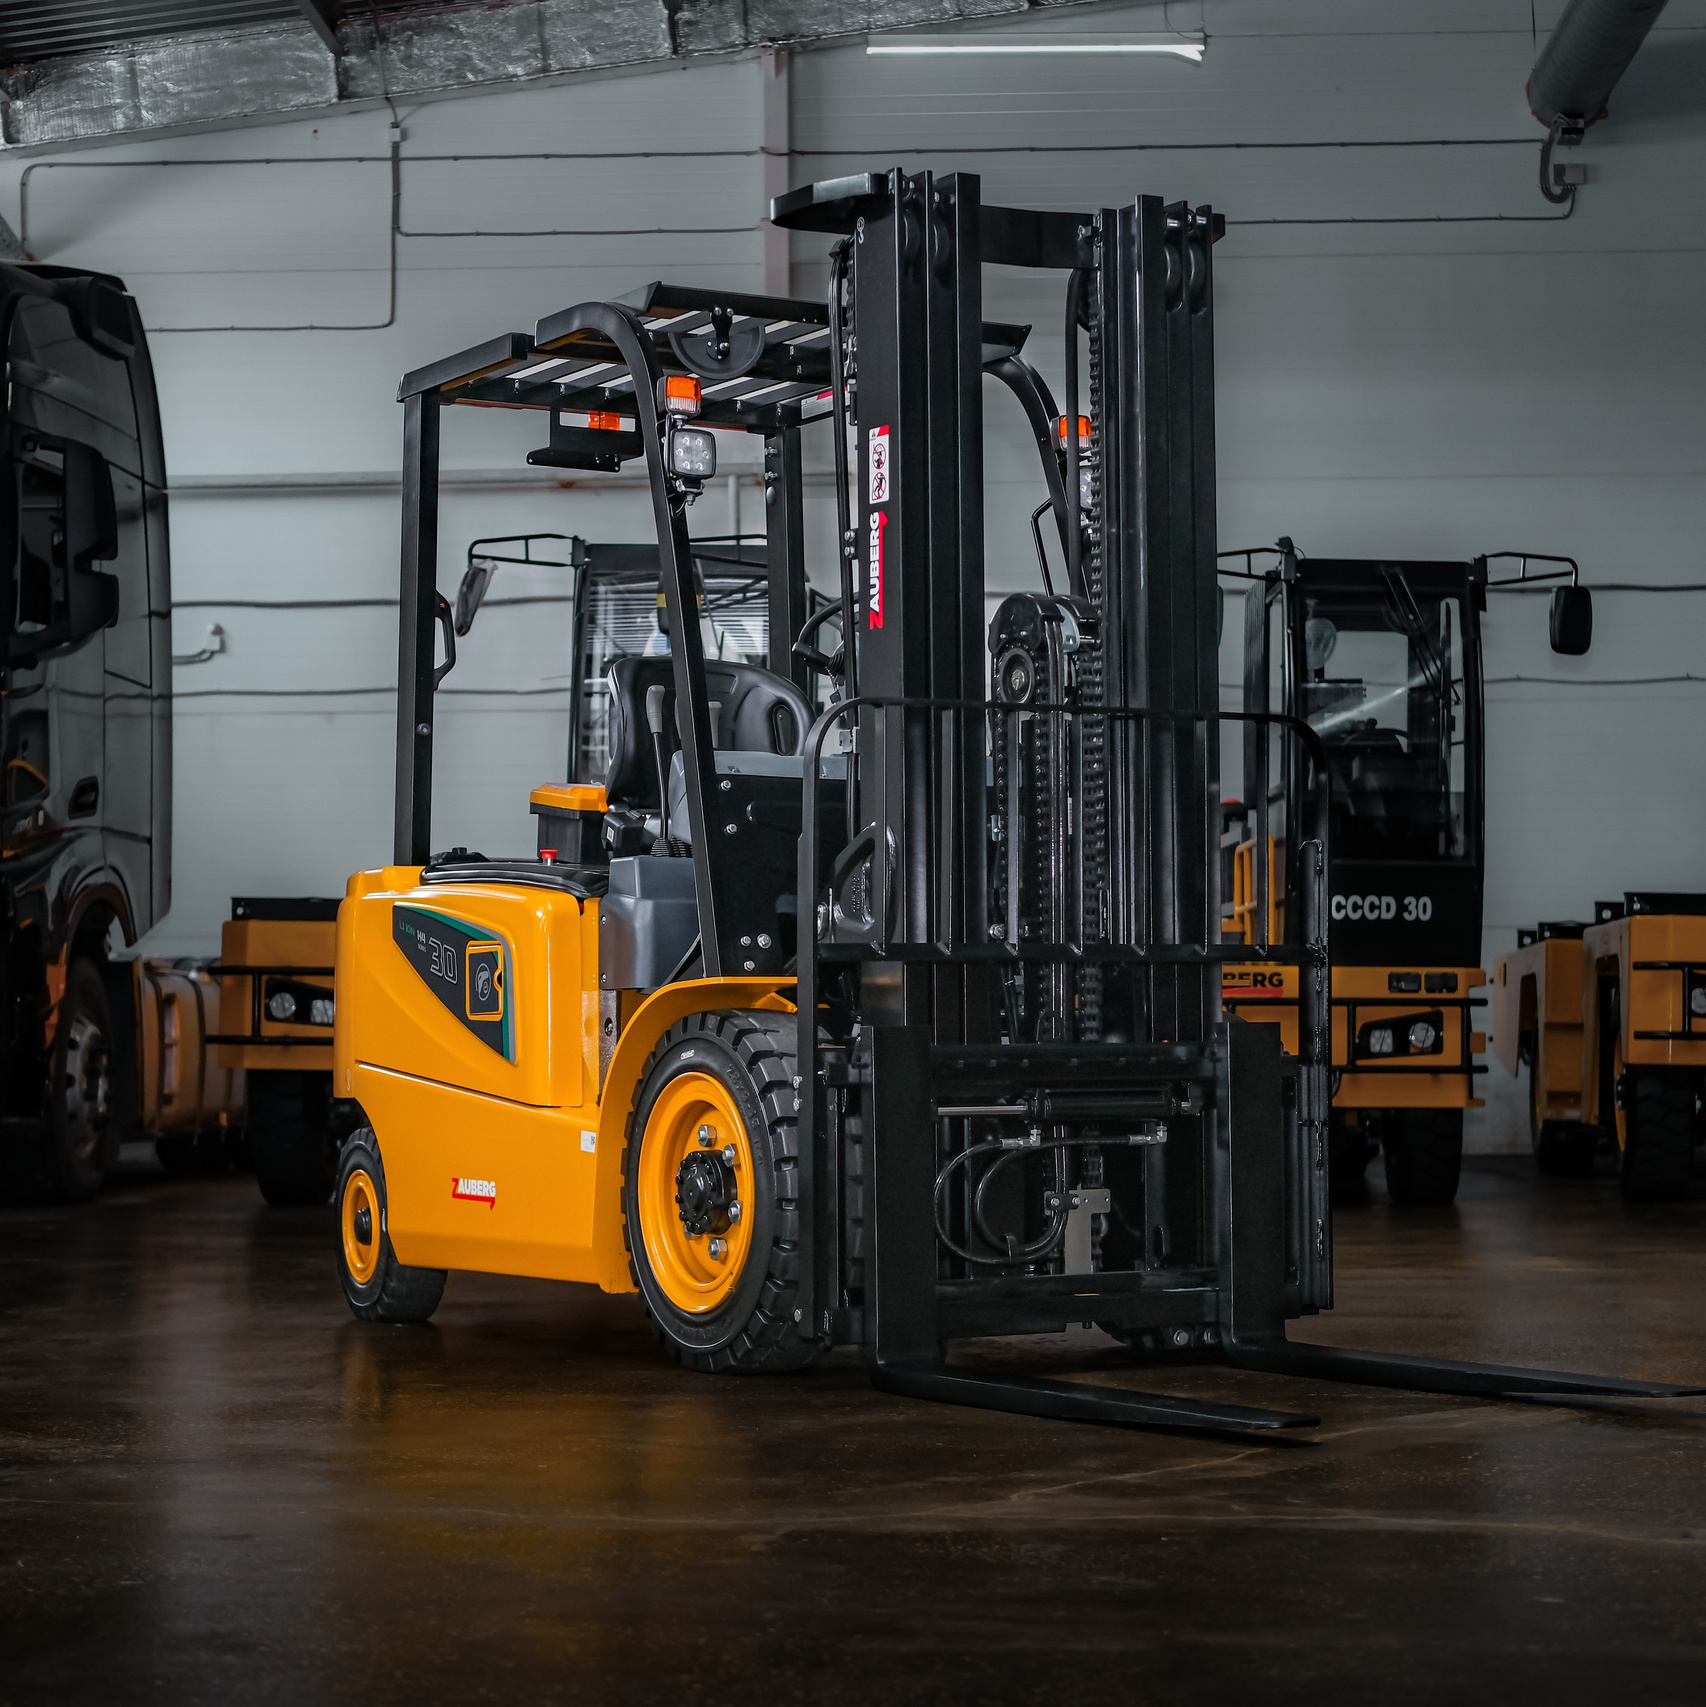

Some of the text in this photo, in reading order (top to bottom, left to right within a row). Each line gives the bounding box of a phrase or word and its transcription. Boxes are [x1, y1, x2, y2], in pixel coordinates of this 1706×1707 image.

[869, 510, 886, 630] ZAUBERG
[1331, 895, 1433, 921] CCCD 30
[429, 937, 458, 984] 30
[452, 1177, 496, 1203] ZAUBERG
